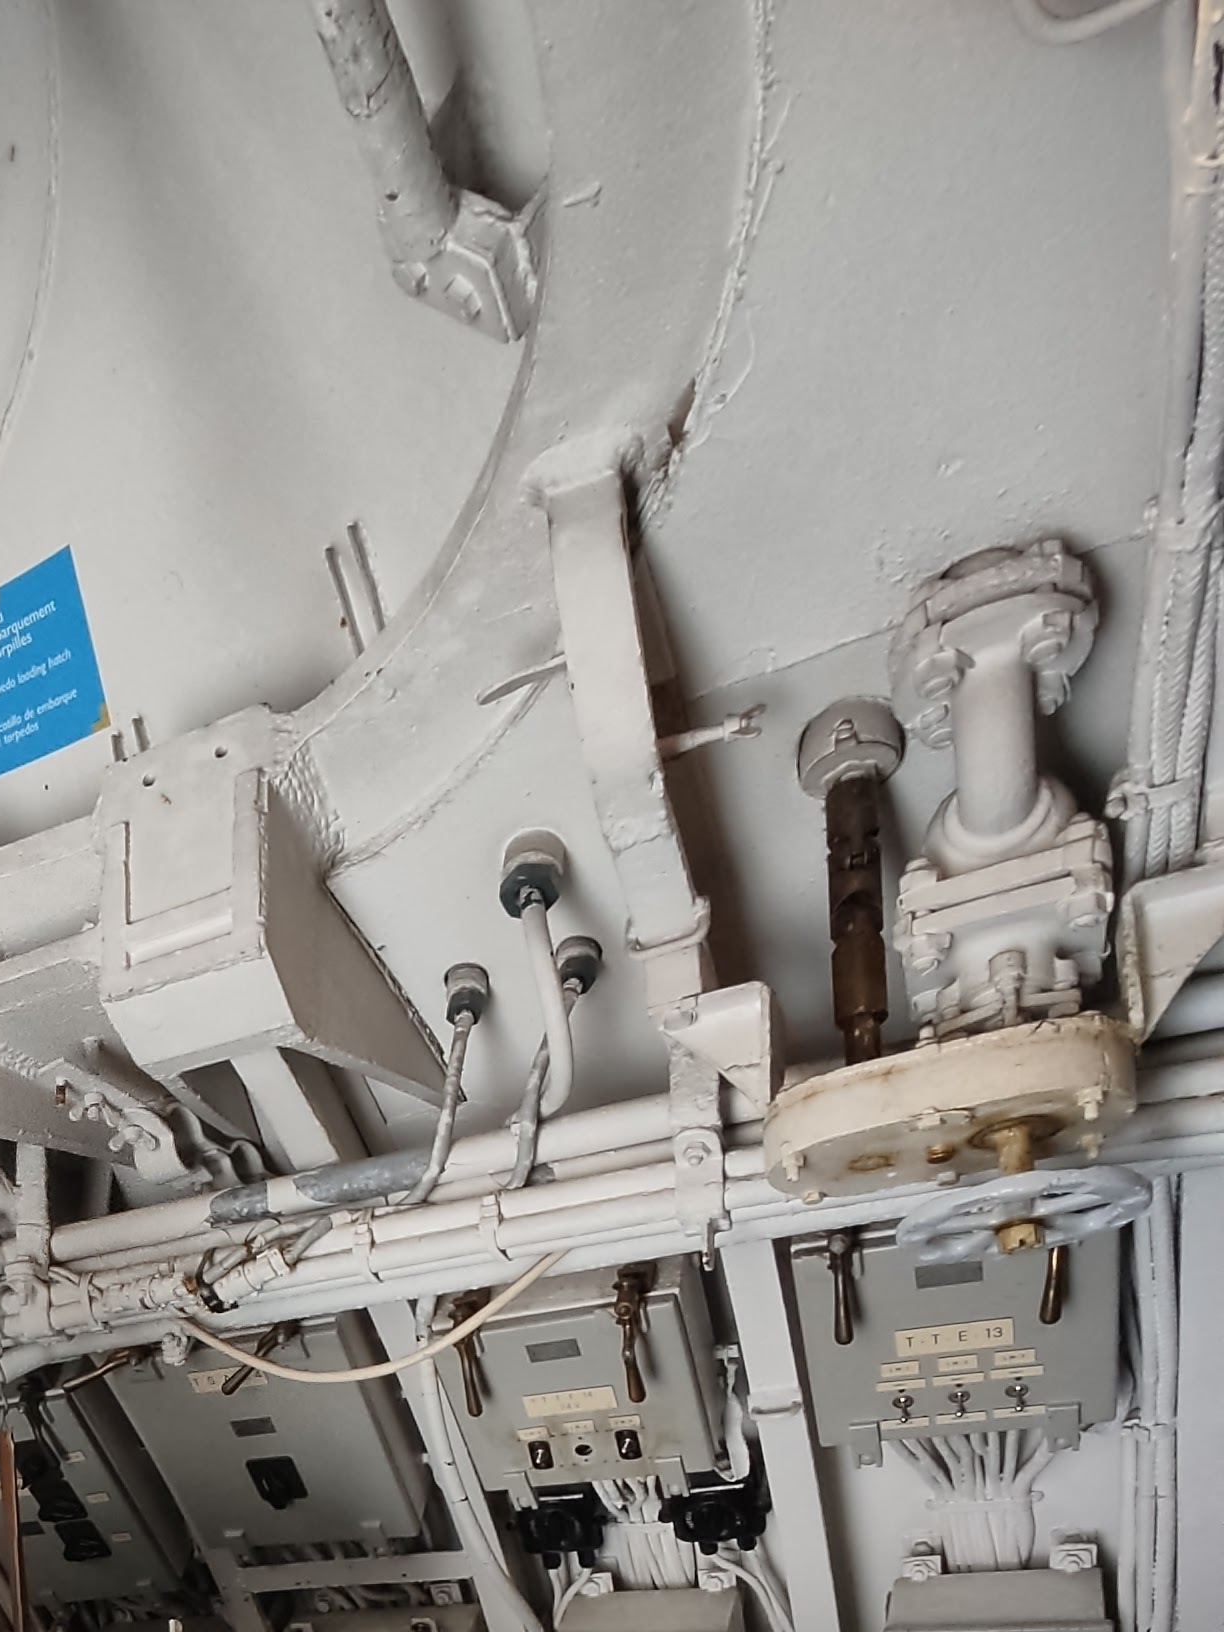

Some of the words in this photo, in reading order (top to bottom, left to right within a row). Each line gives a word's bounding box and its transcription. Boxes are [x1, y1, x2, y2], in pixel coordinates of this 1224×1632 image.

[17, 663, 47, 684] loading
[47, 648, 71, 669] hatch
[24, 708, 35, 721] de
[37, 689, 78, 714] embarque
[3, 721, 39, 744] torpedos
[985, 1327, 1003, 1339] 13
